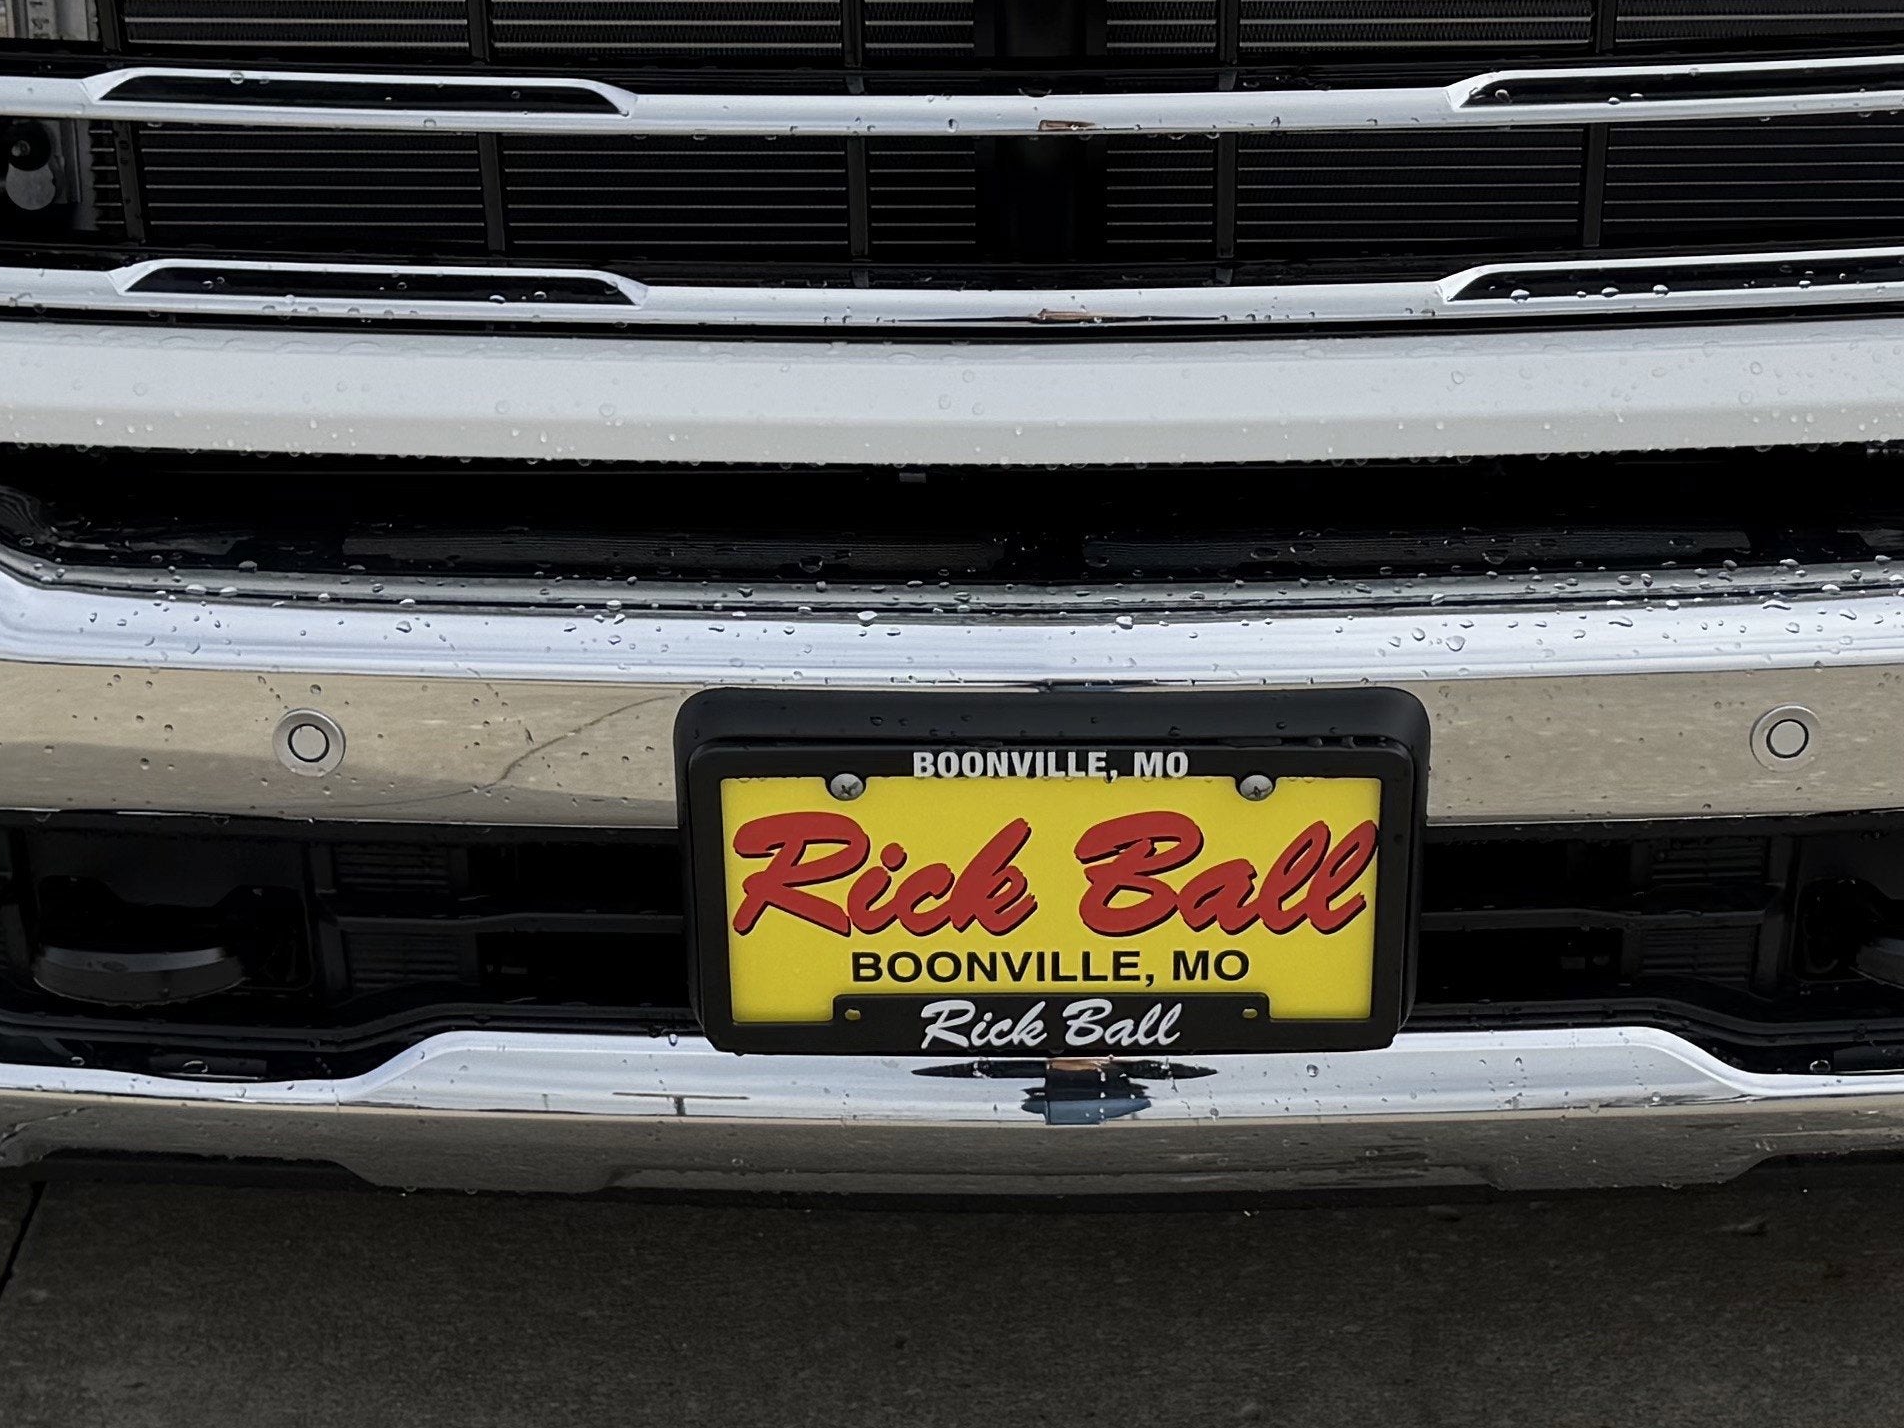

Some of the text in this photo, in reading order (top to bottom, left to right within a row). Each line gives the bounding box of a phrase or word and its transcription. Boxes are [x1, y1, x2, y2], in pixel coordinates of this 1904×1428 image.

[912, 750, 1190, 783] BOONVILLE, MO
[732, 810, 1381, 938] Rick Ball
[850, 949, 1251, 988] BOONVILLE, MO
[920, 999, 1183, 1051] Rick Ball
